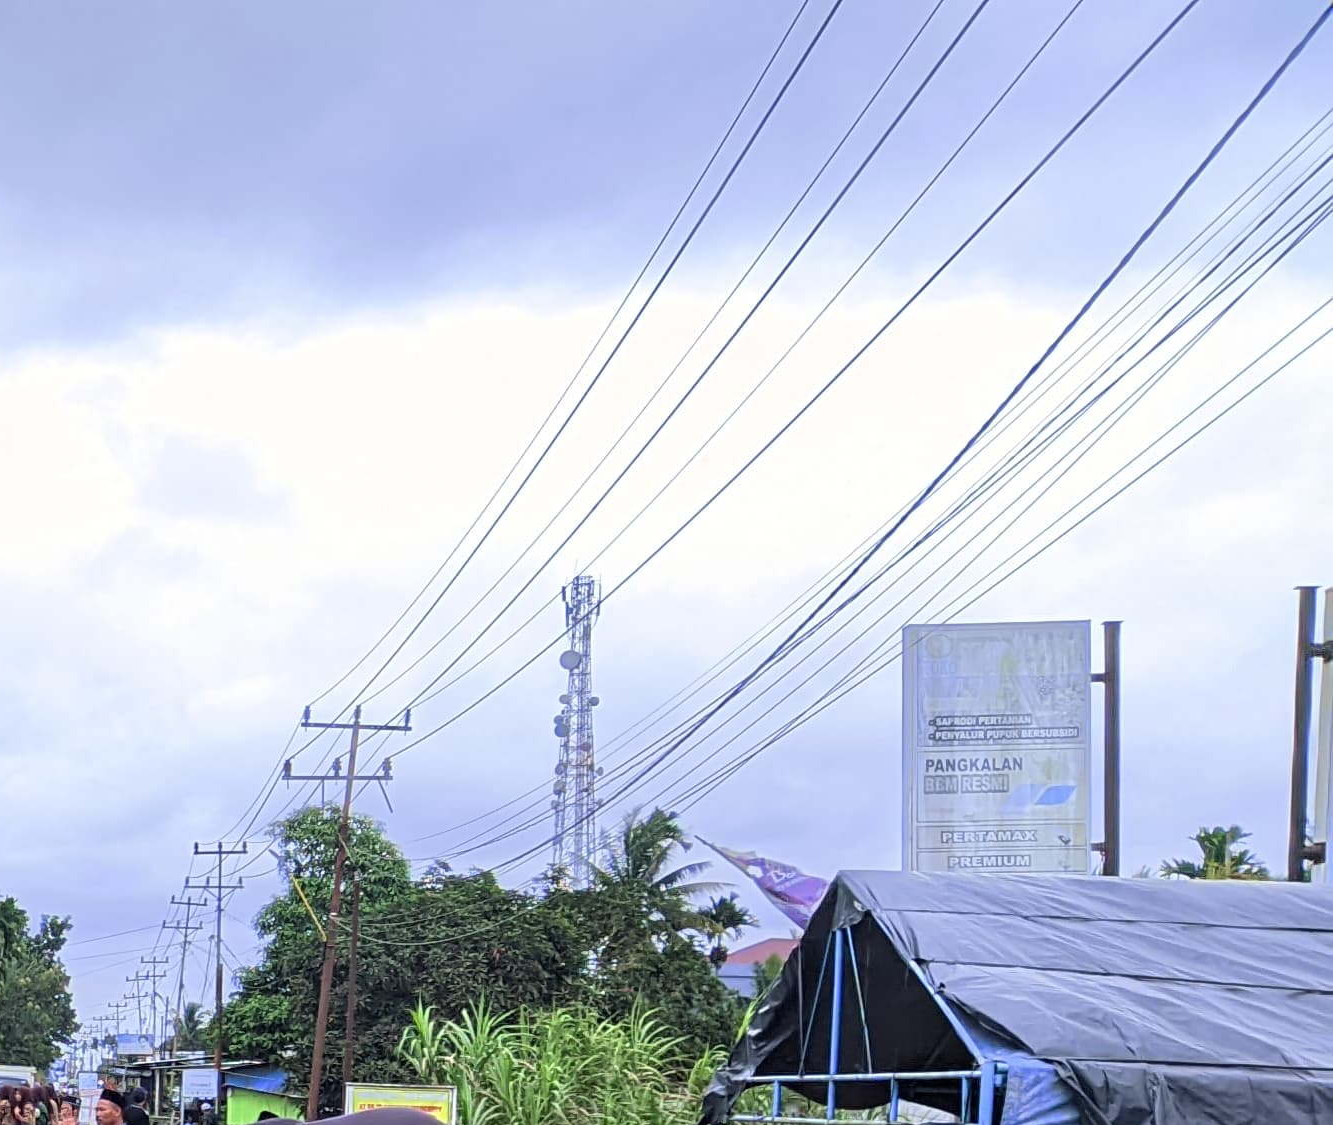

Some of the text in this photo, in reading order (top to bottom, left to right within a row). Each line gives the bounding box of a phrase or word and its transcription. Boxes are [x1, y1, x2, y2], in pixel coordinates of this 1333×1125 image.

[978, 714, 1032, 725] PERTANIAN
[935, 728, 1077, 740] PENYALUR PUPUK BERSUBSIDI
[925, 757, 1023, 772] PANGKALAN
[924, 774, 1009, 794] BBM RESMI
[941, 830, 1037, 843] PERTAMAX
[948, 855, 1031, 868] PREMIUM
